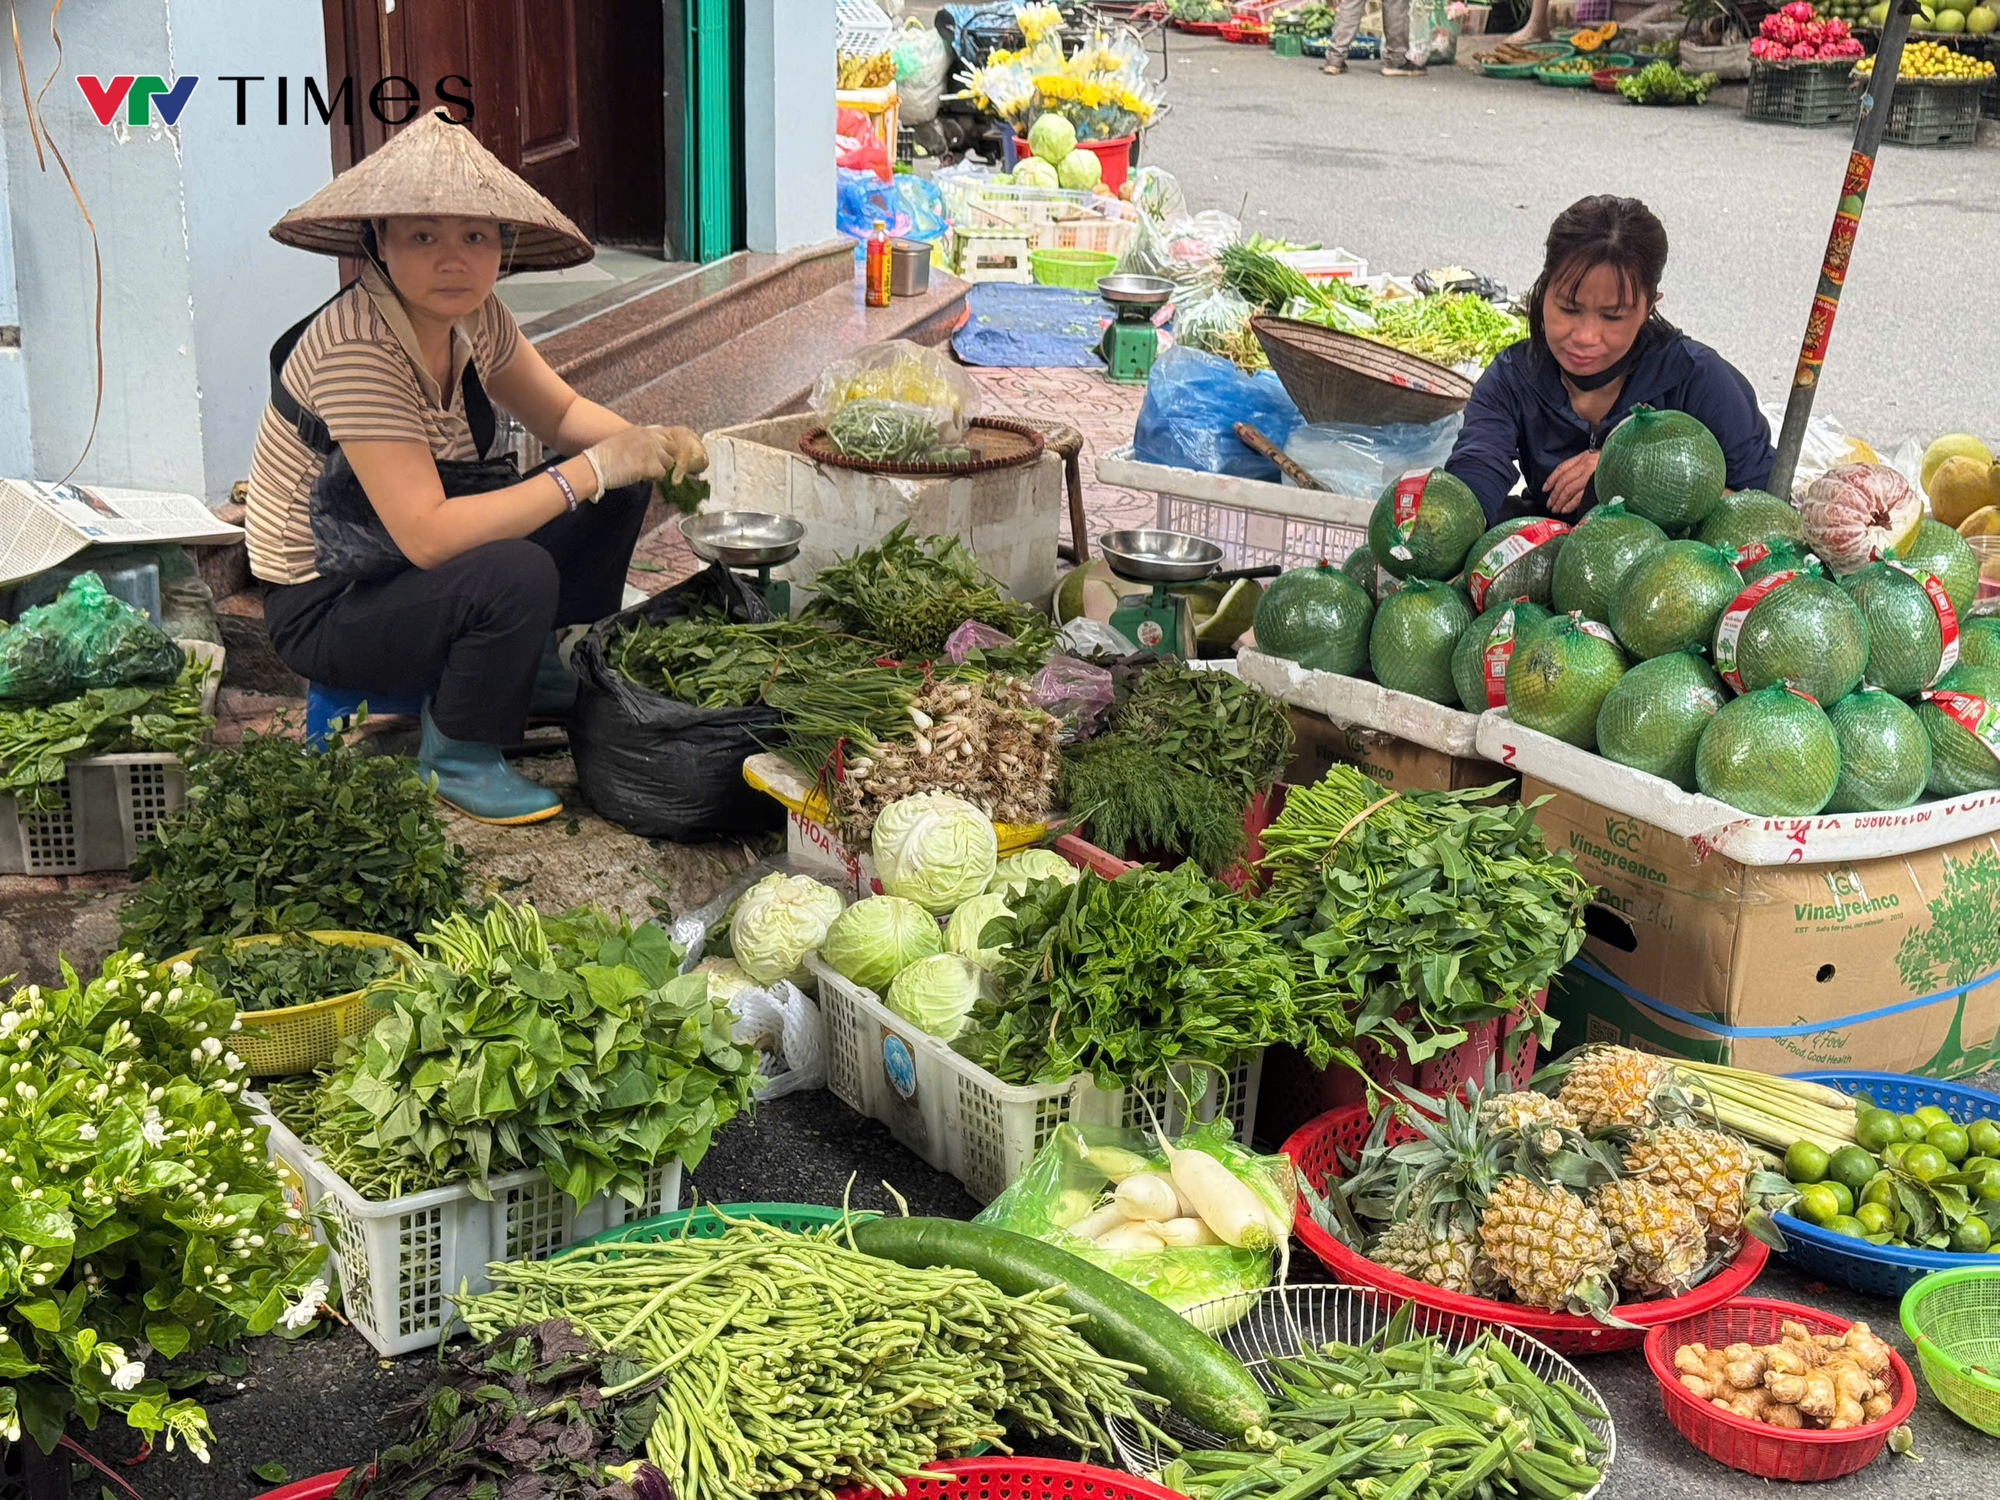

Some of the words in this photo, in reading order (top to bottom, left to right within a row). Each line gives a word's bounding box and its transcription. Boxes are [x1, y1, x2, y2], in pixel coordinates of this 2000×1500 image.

[1569, 829, 1668, 884] Vinagreenco
[1794, 893, 1900, 923] Vinagreenco
[1815, 925, 1831, 933] Safe
